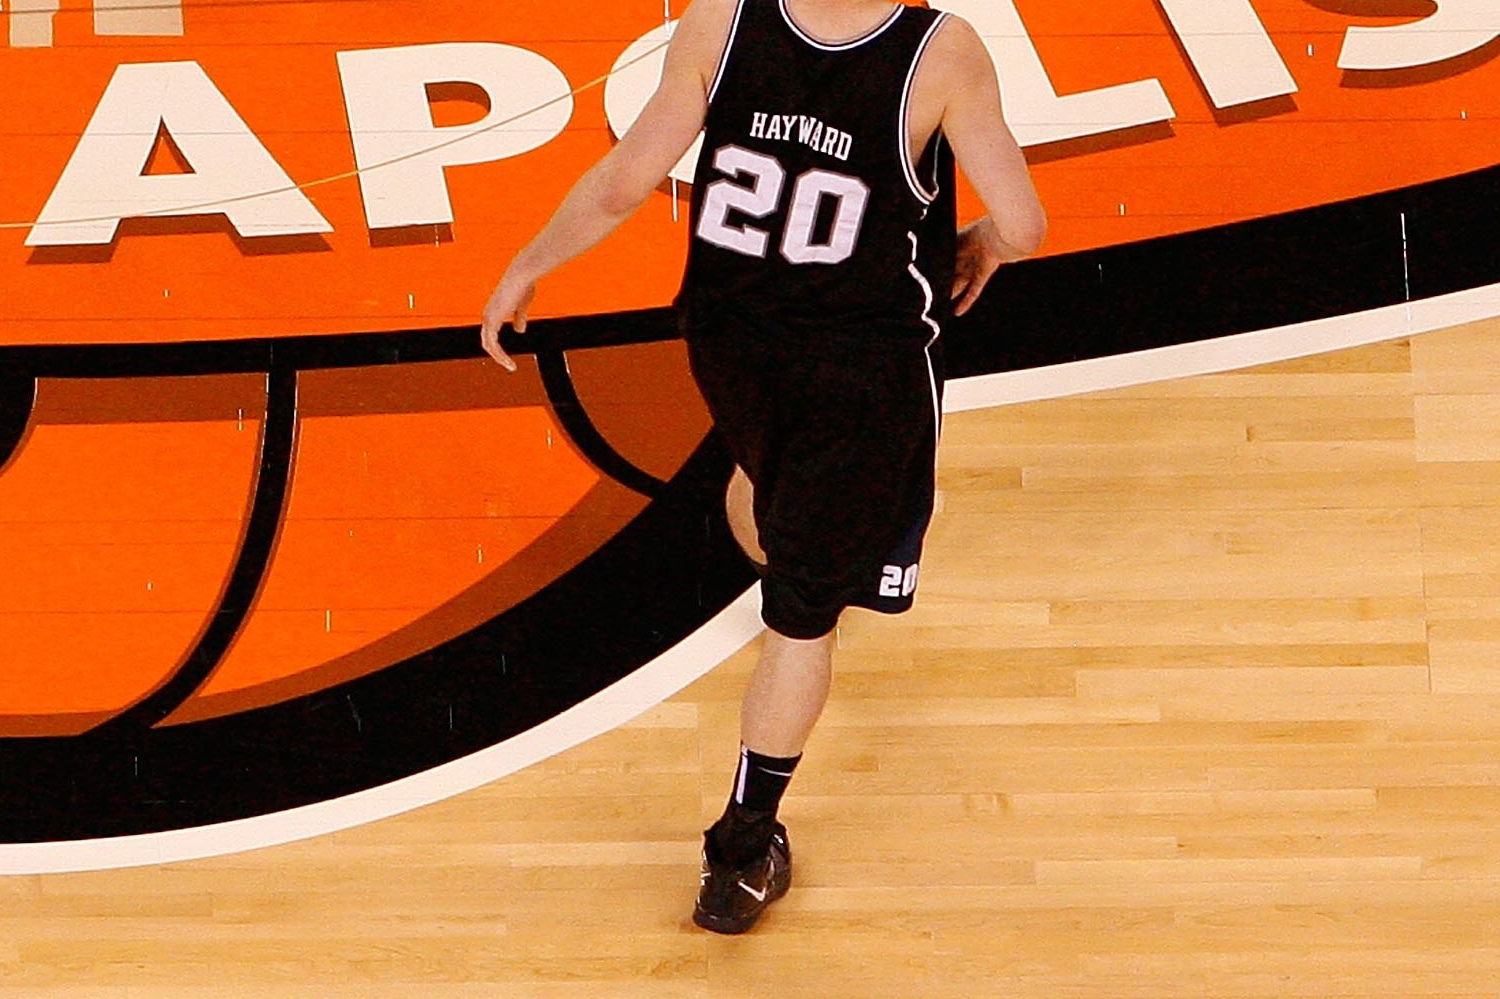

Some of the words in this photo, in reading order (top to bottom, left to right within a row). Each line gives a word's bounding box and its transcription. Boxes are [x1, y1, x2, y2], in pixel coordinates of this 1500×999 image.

[749, 111, 853, 161] HAYWARD
[696, 143, 871, 265] 20
[878, 563, 919, 597] 20
